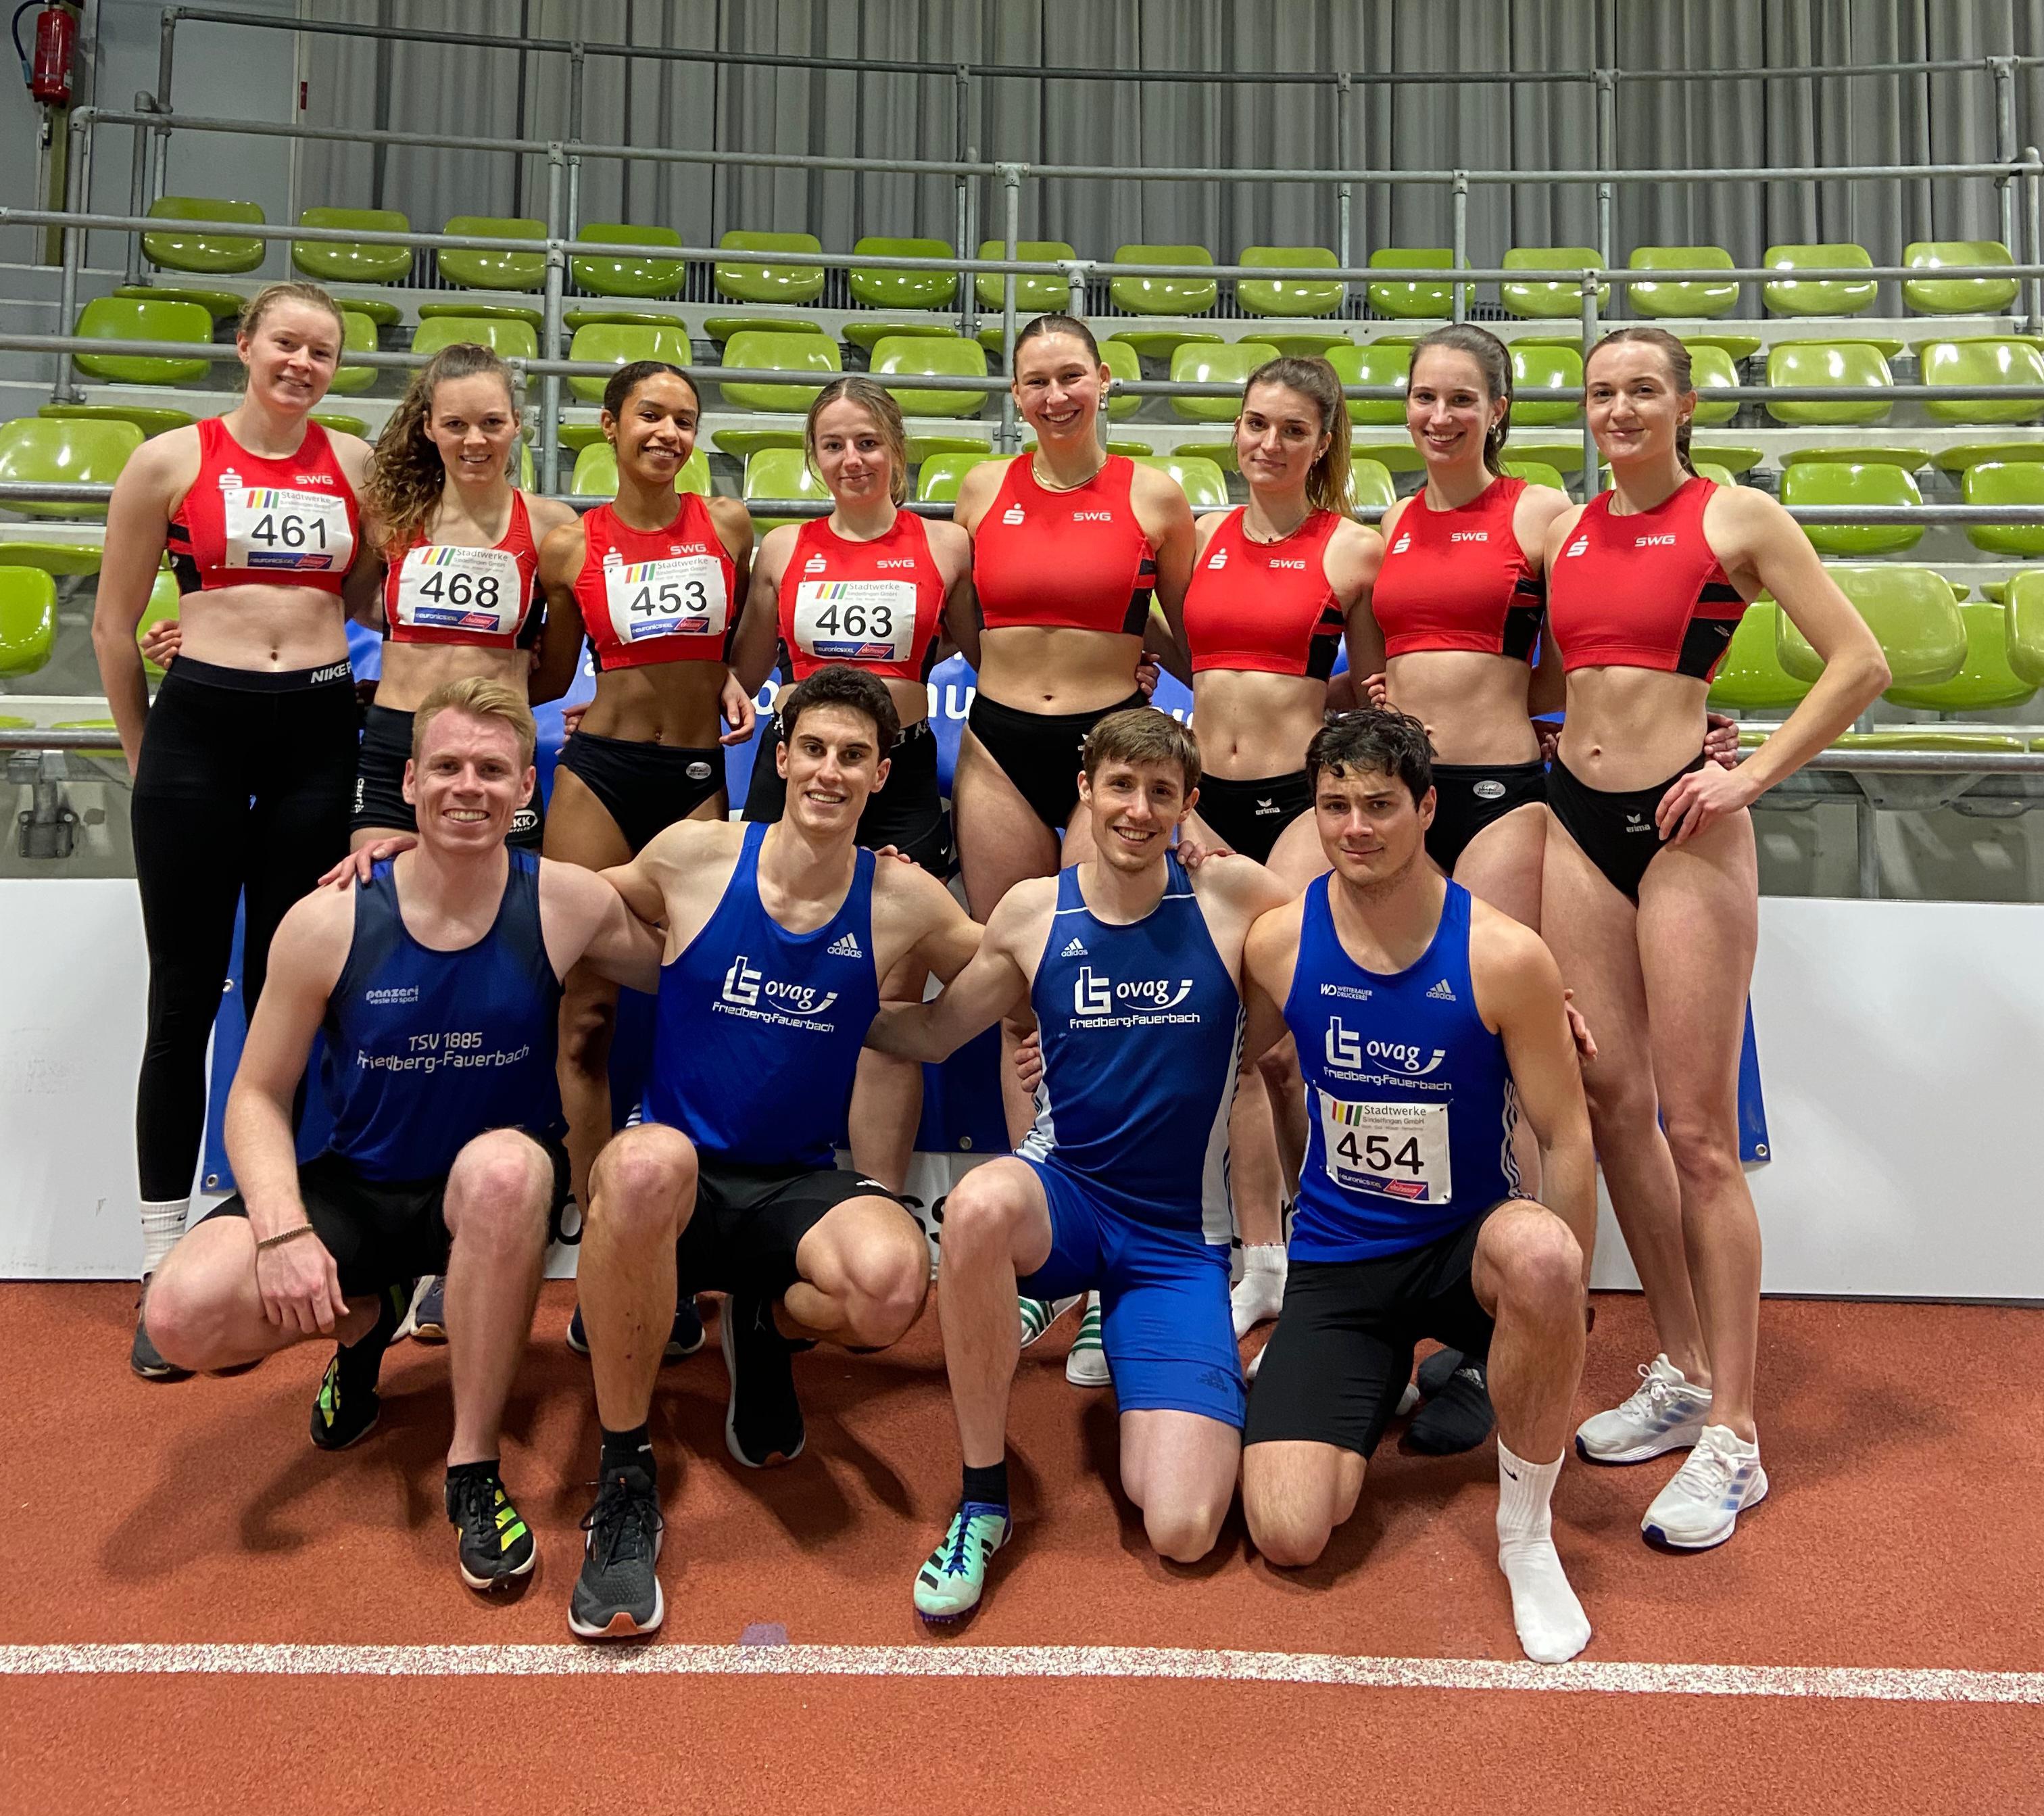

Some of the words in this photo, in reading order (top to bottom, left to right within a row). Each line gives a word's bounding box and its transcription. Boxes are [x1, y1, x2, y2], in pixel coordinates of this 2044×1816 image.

[295, 475, 334, 485] SWG
[281, 491, 331, 504] Stadtwerke
[1073, 512, 1111, 521] SWG
[251, 514, 326, 549] 461
[1451, 532, 1488, 542] SWG
[1634, 535, 1676, 547] SWG
[456, 548, 508, 563] Stadtwerke
[670, 544, 706, 555] SWG
[657, 558, 708, 570] Stadtwerke
[877, 559, 915, 568] SWG
[1269, 559, 1306, 569] SWG
[420, 571, 499, 608] 468
[631, 581, 707, 617] 453
[815, 604, 892, 638] 463
[310, 663, 347, 684] NIKE
[1255, 807, 1280, 815] erima
[1626, 824, 1651, 832] erima
[827, 946, 862, 959] adidas
[1061, 949, 1088, 957] adidas
[366, 985, 419, 1001] panzeri
[764, 980, 816, 1009] ovag
[1116, 980, 1169, 1005] ovag
[1337, 991, 1367, 1001] DRUCKEREI
[1426, 991, 1456, 1001] adidas
[399, 995, 418, 1004] sport
[712, 1001, 834, 1032] Friedberg-Fauerbach
[1069, 1013, 1200, 1029] Friedberg-Fauerbach
[408, 1033, 439, 1051] TSV
[443, 1032, 483, 1049] 1885
[357, 1043, 529, 1074] Friedberg-Fauerbach
[1367, 1041, 1420, 1070] ovag
[1323, 1066, 1452, 1090] Friedberg-Fauerbach
[1365, 1104, 1426, 1116] Stadtwerke
[1336, 1131, 1424, 1175] 454
